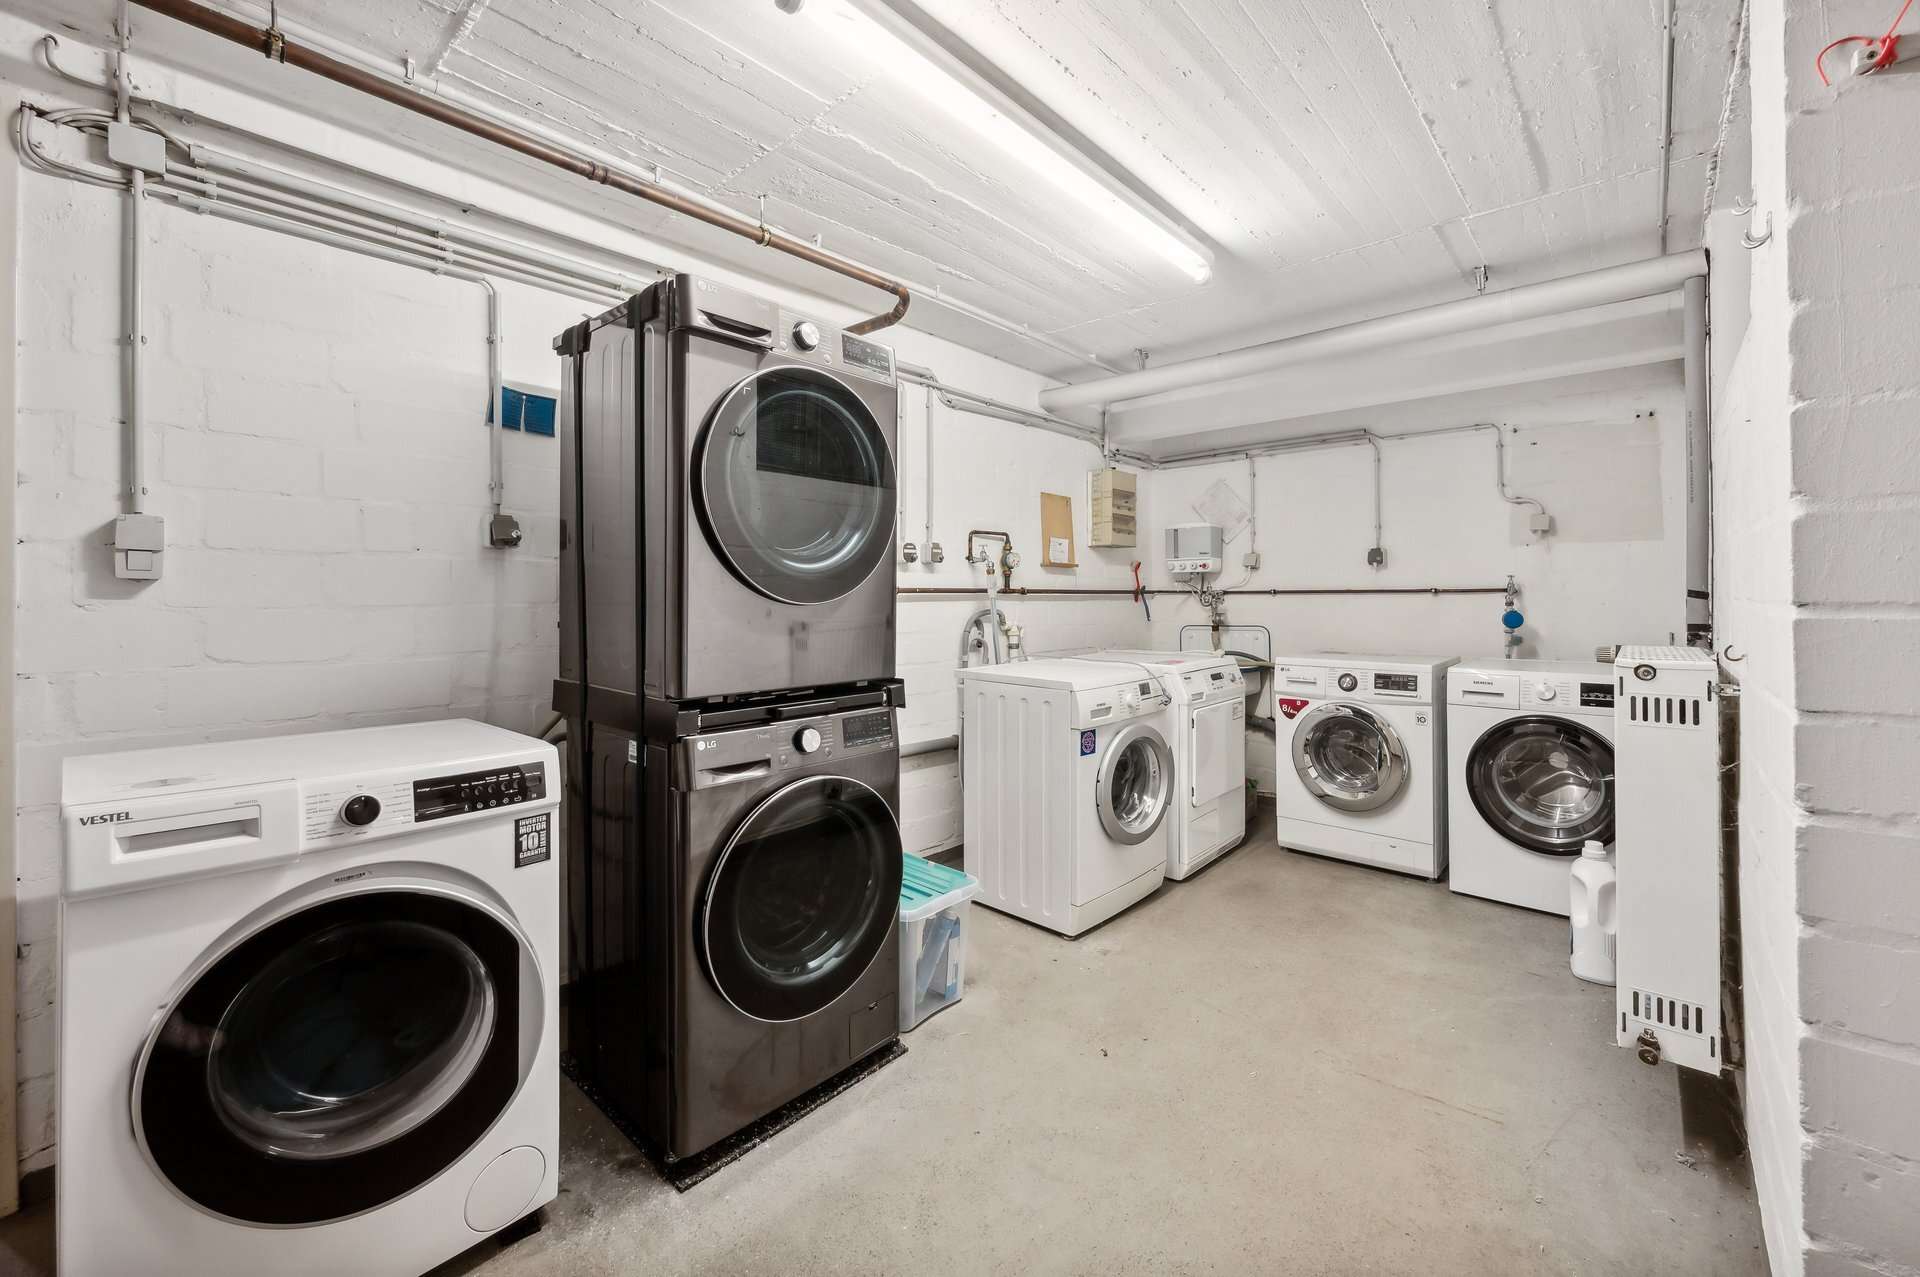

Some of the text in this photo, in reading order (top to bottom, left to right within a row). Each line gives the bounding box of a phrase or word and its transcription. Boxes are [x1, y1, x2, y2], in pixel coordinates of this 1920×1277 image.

[706, 740, 717, 749] LG
[79, 811, 133, 826] VESTEL
[519, 815, 547, 826] INVERTER
[519, 822, 547, 835] MOTOR
[519, 832, 539, 852] 10
[519, 847, 547, 859] GARANTIE
